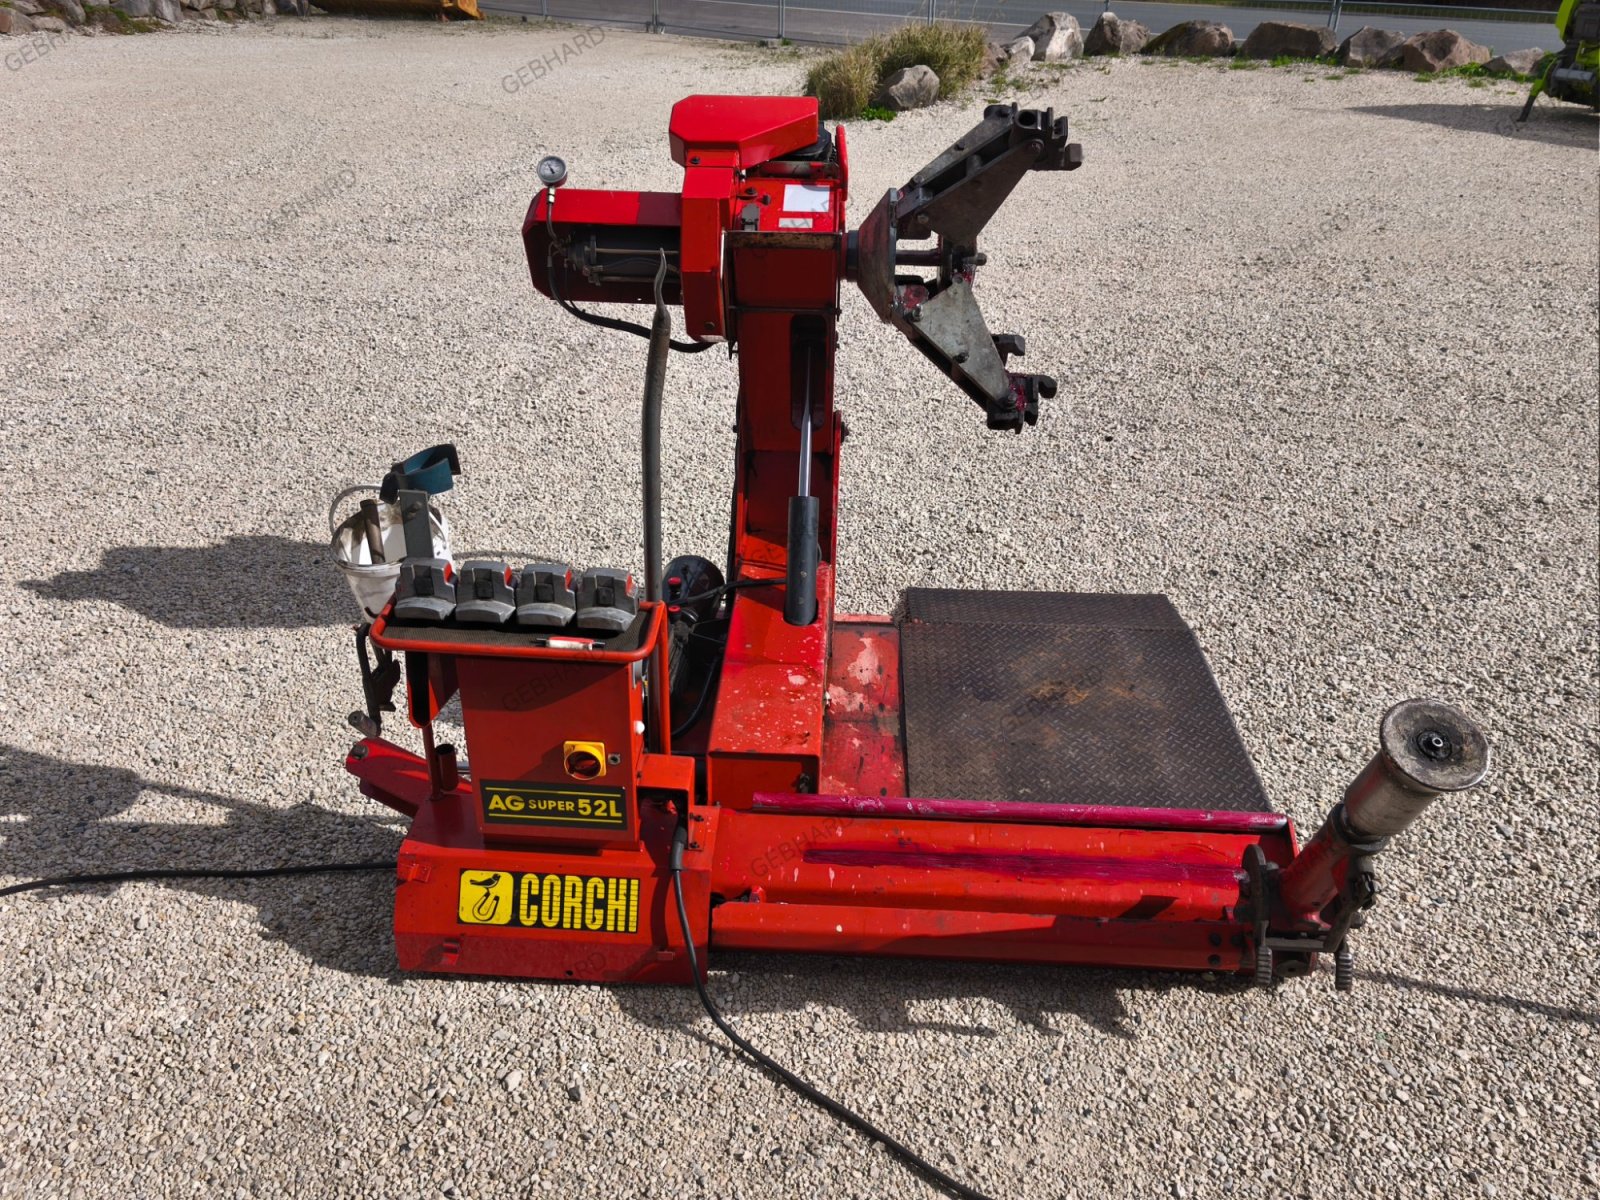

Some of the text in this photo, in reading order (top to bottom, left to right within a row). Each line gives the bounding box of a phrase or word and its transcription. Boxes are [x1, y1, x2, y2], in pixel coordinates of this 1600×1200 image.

[488, 794, 622, 818] AG SUPER 52L
